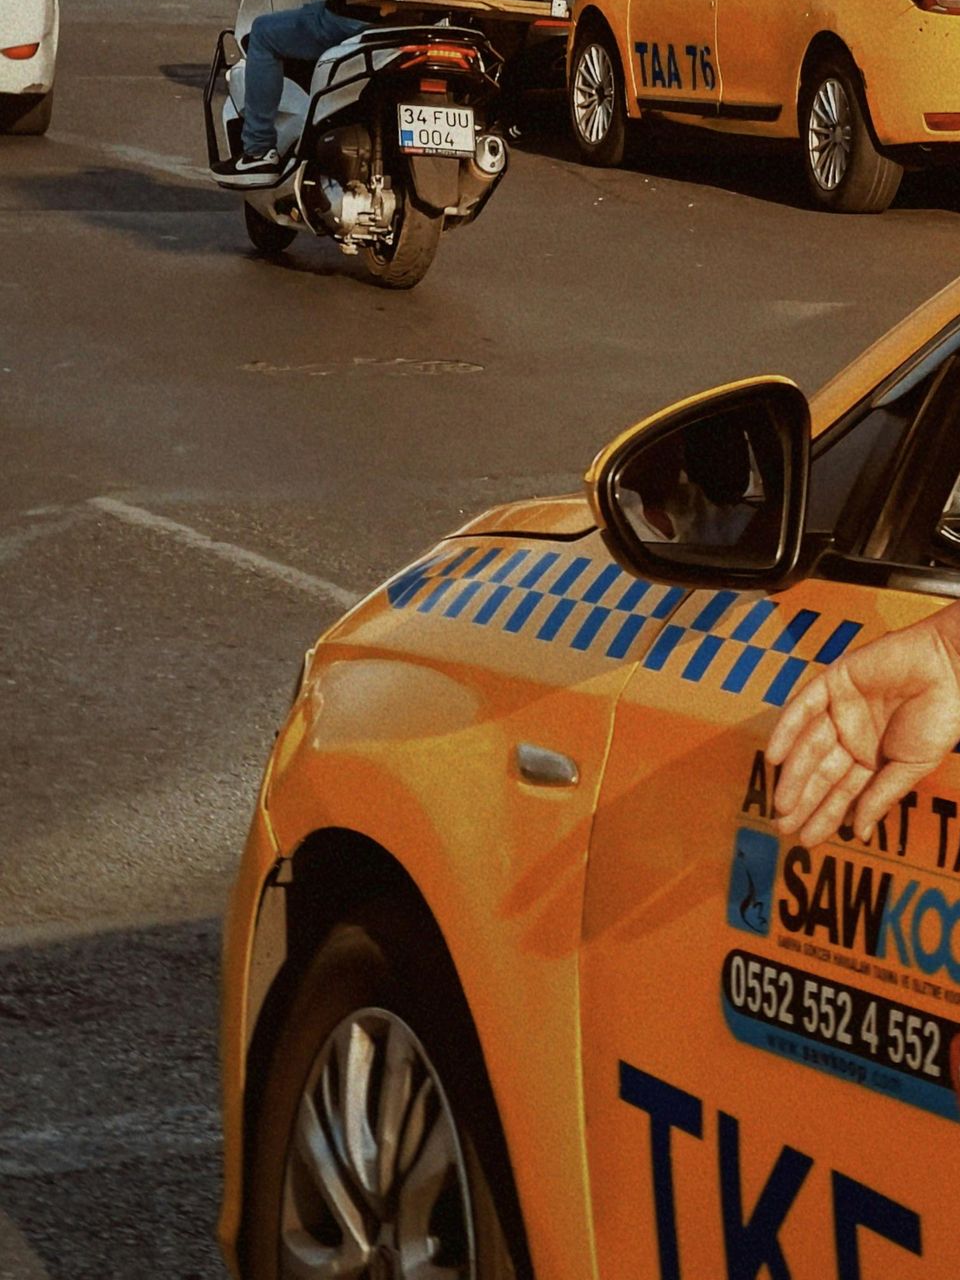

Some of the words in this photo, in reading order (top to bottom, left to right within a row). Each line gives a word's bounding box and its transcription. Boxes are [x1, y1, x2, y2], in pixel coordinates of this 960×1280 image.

[634, 41, 682, 89] TAA
[685, 44, 716, 91] 76
[404, 108, 427, 124] 34
[433, 111, 469, 128] FUU
[419, 129, 455, 147] 004
[731, 955, 794, 1024] 0552
[803, 980, 853, 1046] 552
[861, 1001, 879, 1054] 4
[888, 1009, 941, 1077] 552
